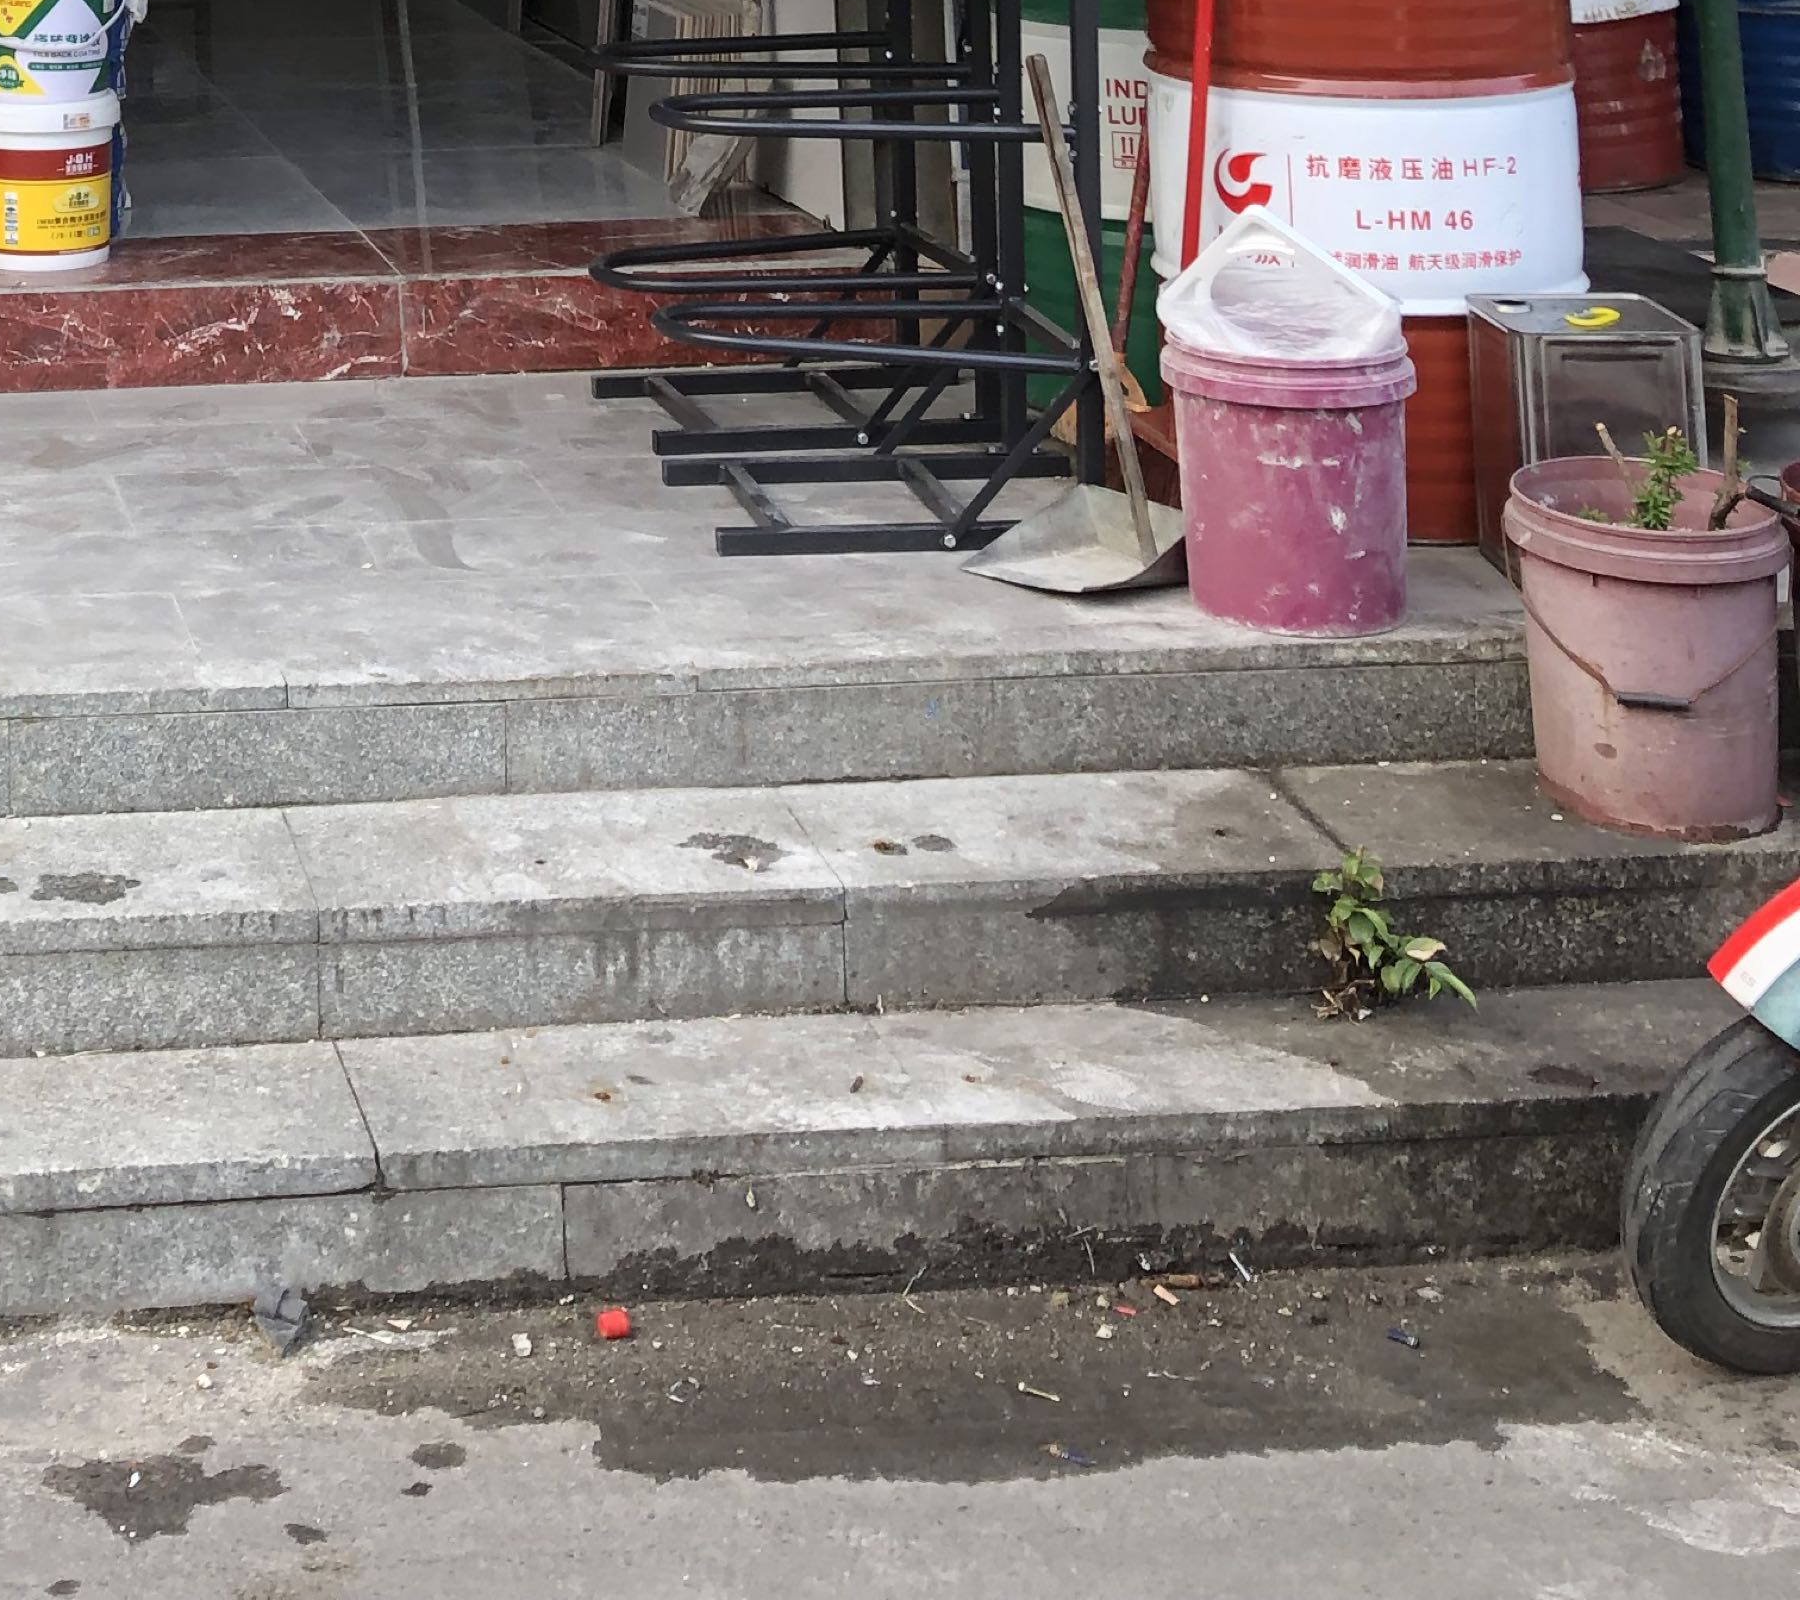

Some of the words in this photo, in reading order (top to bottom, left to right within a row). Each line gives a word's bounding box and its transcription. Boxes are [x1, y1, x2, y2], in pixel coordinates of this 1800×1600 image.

[1107, 105, 1147, 126] LU
[1304, 154, 1454, 181] 抗磨液压油
[1463, 155, 1518, 176] HF-2
[1356, 209, 1432, 231] L-HM
[1443, 209, 1475, 231] 46
[1407, 249, 1523, 272] 航天级润滑保护
